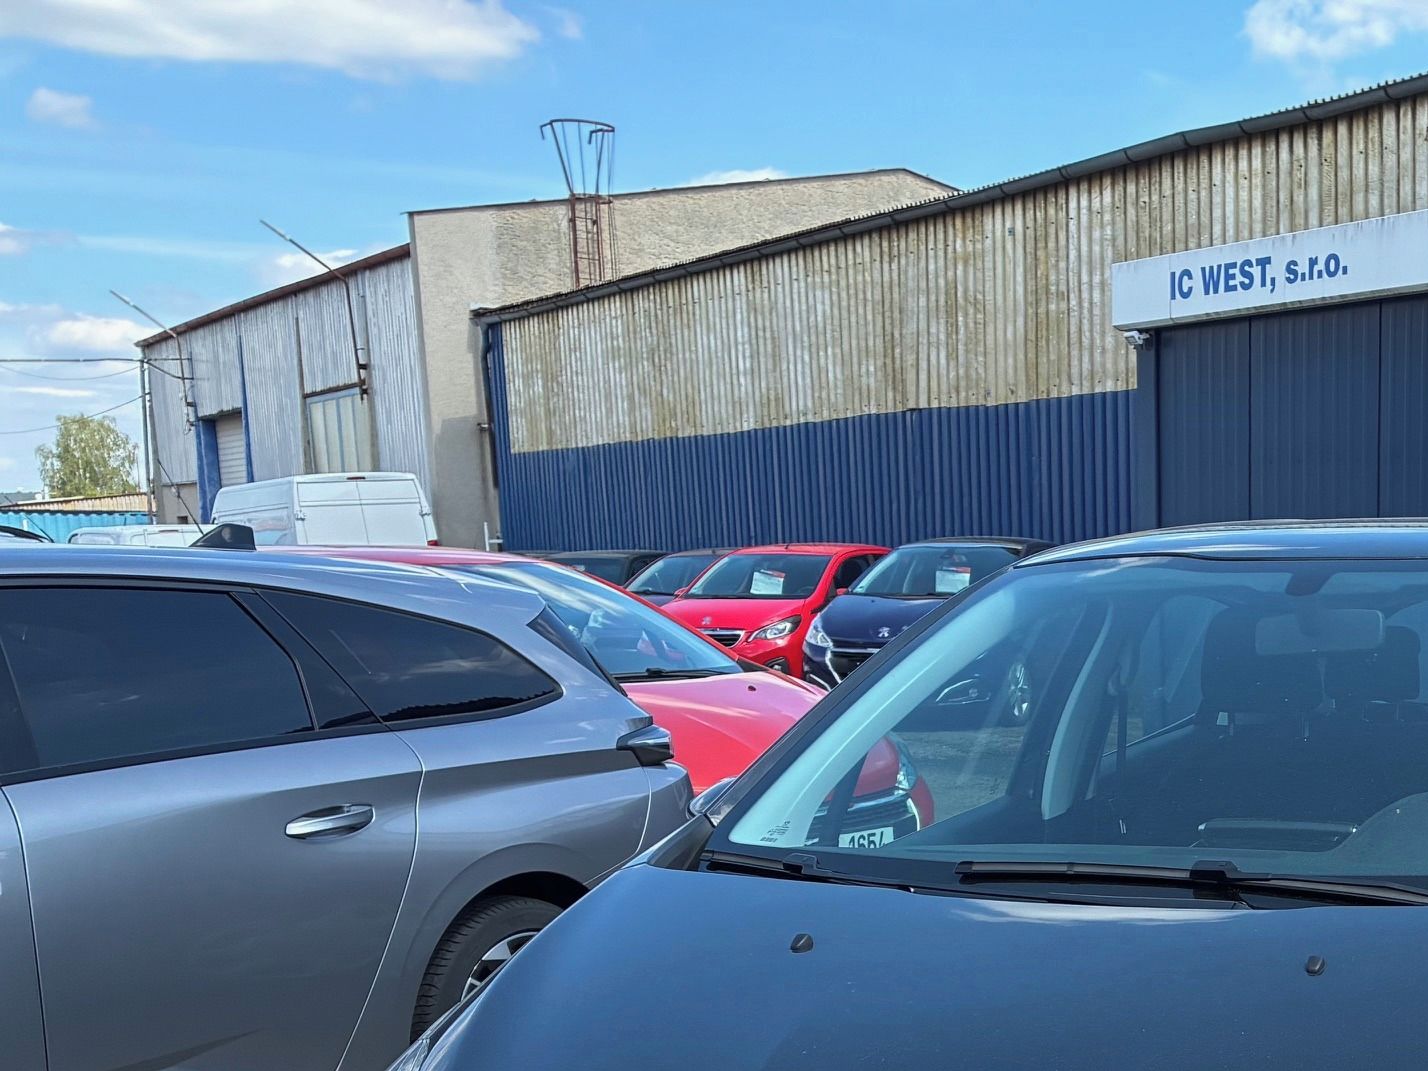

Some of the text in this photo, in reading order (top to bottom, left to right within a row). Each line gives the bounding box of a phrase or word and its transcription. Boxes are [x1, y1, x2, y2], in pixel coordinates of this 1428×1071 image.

[1170, 253, 1348, 300] IC WEST, s.r.o.
